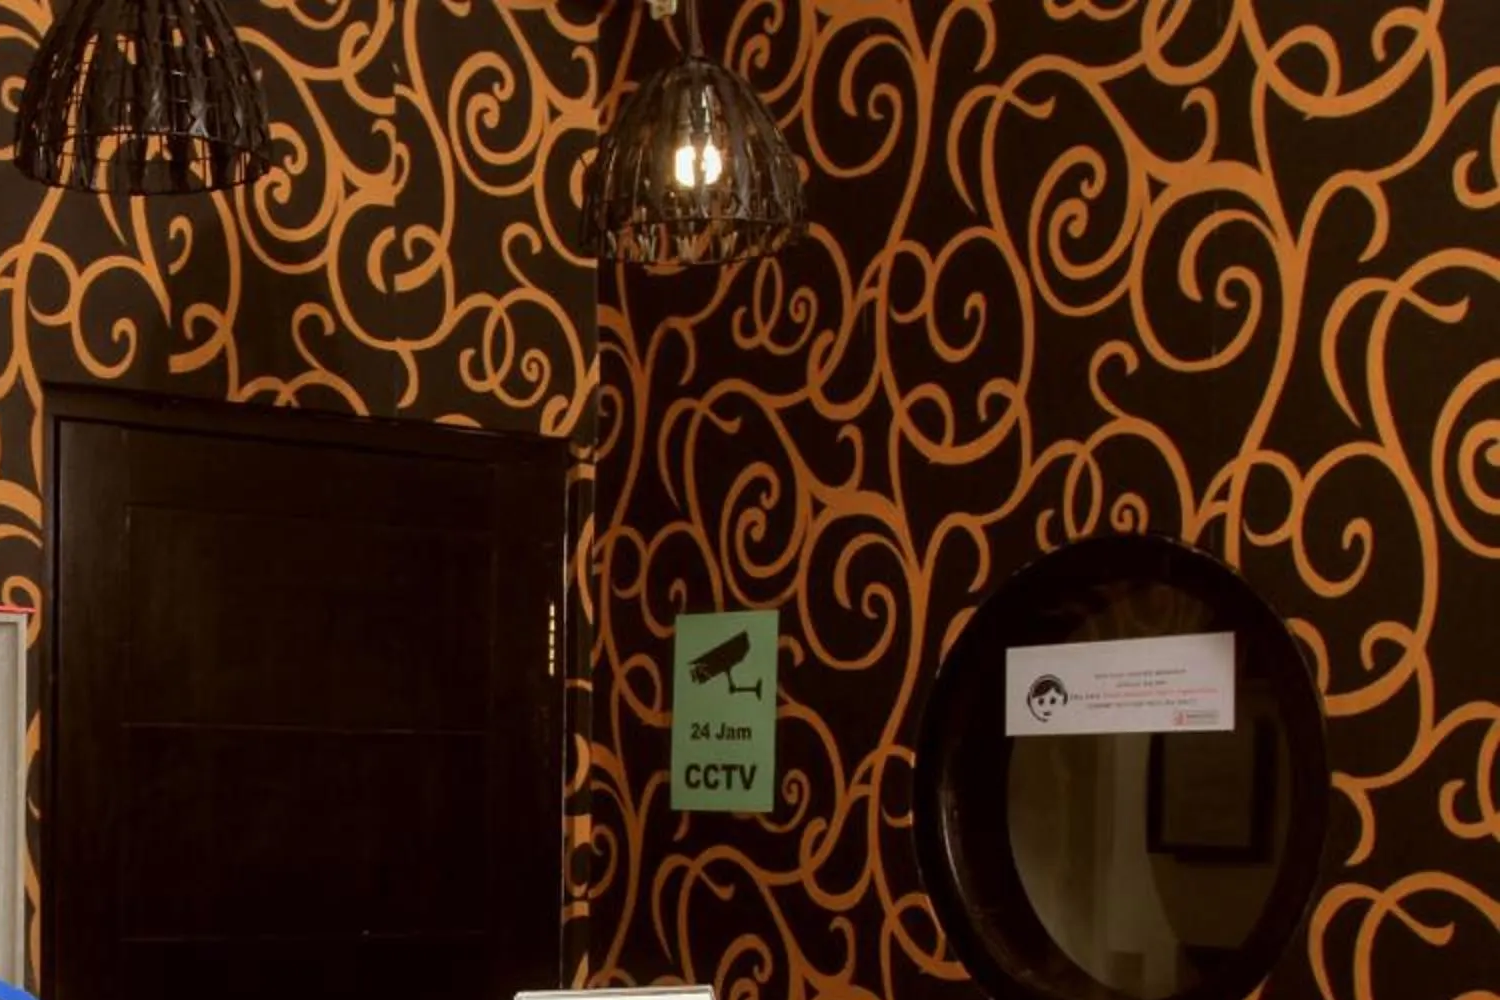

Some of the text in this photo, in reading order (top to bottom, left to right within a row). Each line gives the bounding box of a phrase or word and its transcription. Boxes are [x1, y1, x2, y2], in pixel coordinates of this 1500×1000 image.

[690, 722, 752, 741] 24 Jam
[684, 763, 758, 791] CCTV
